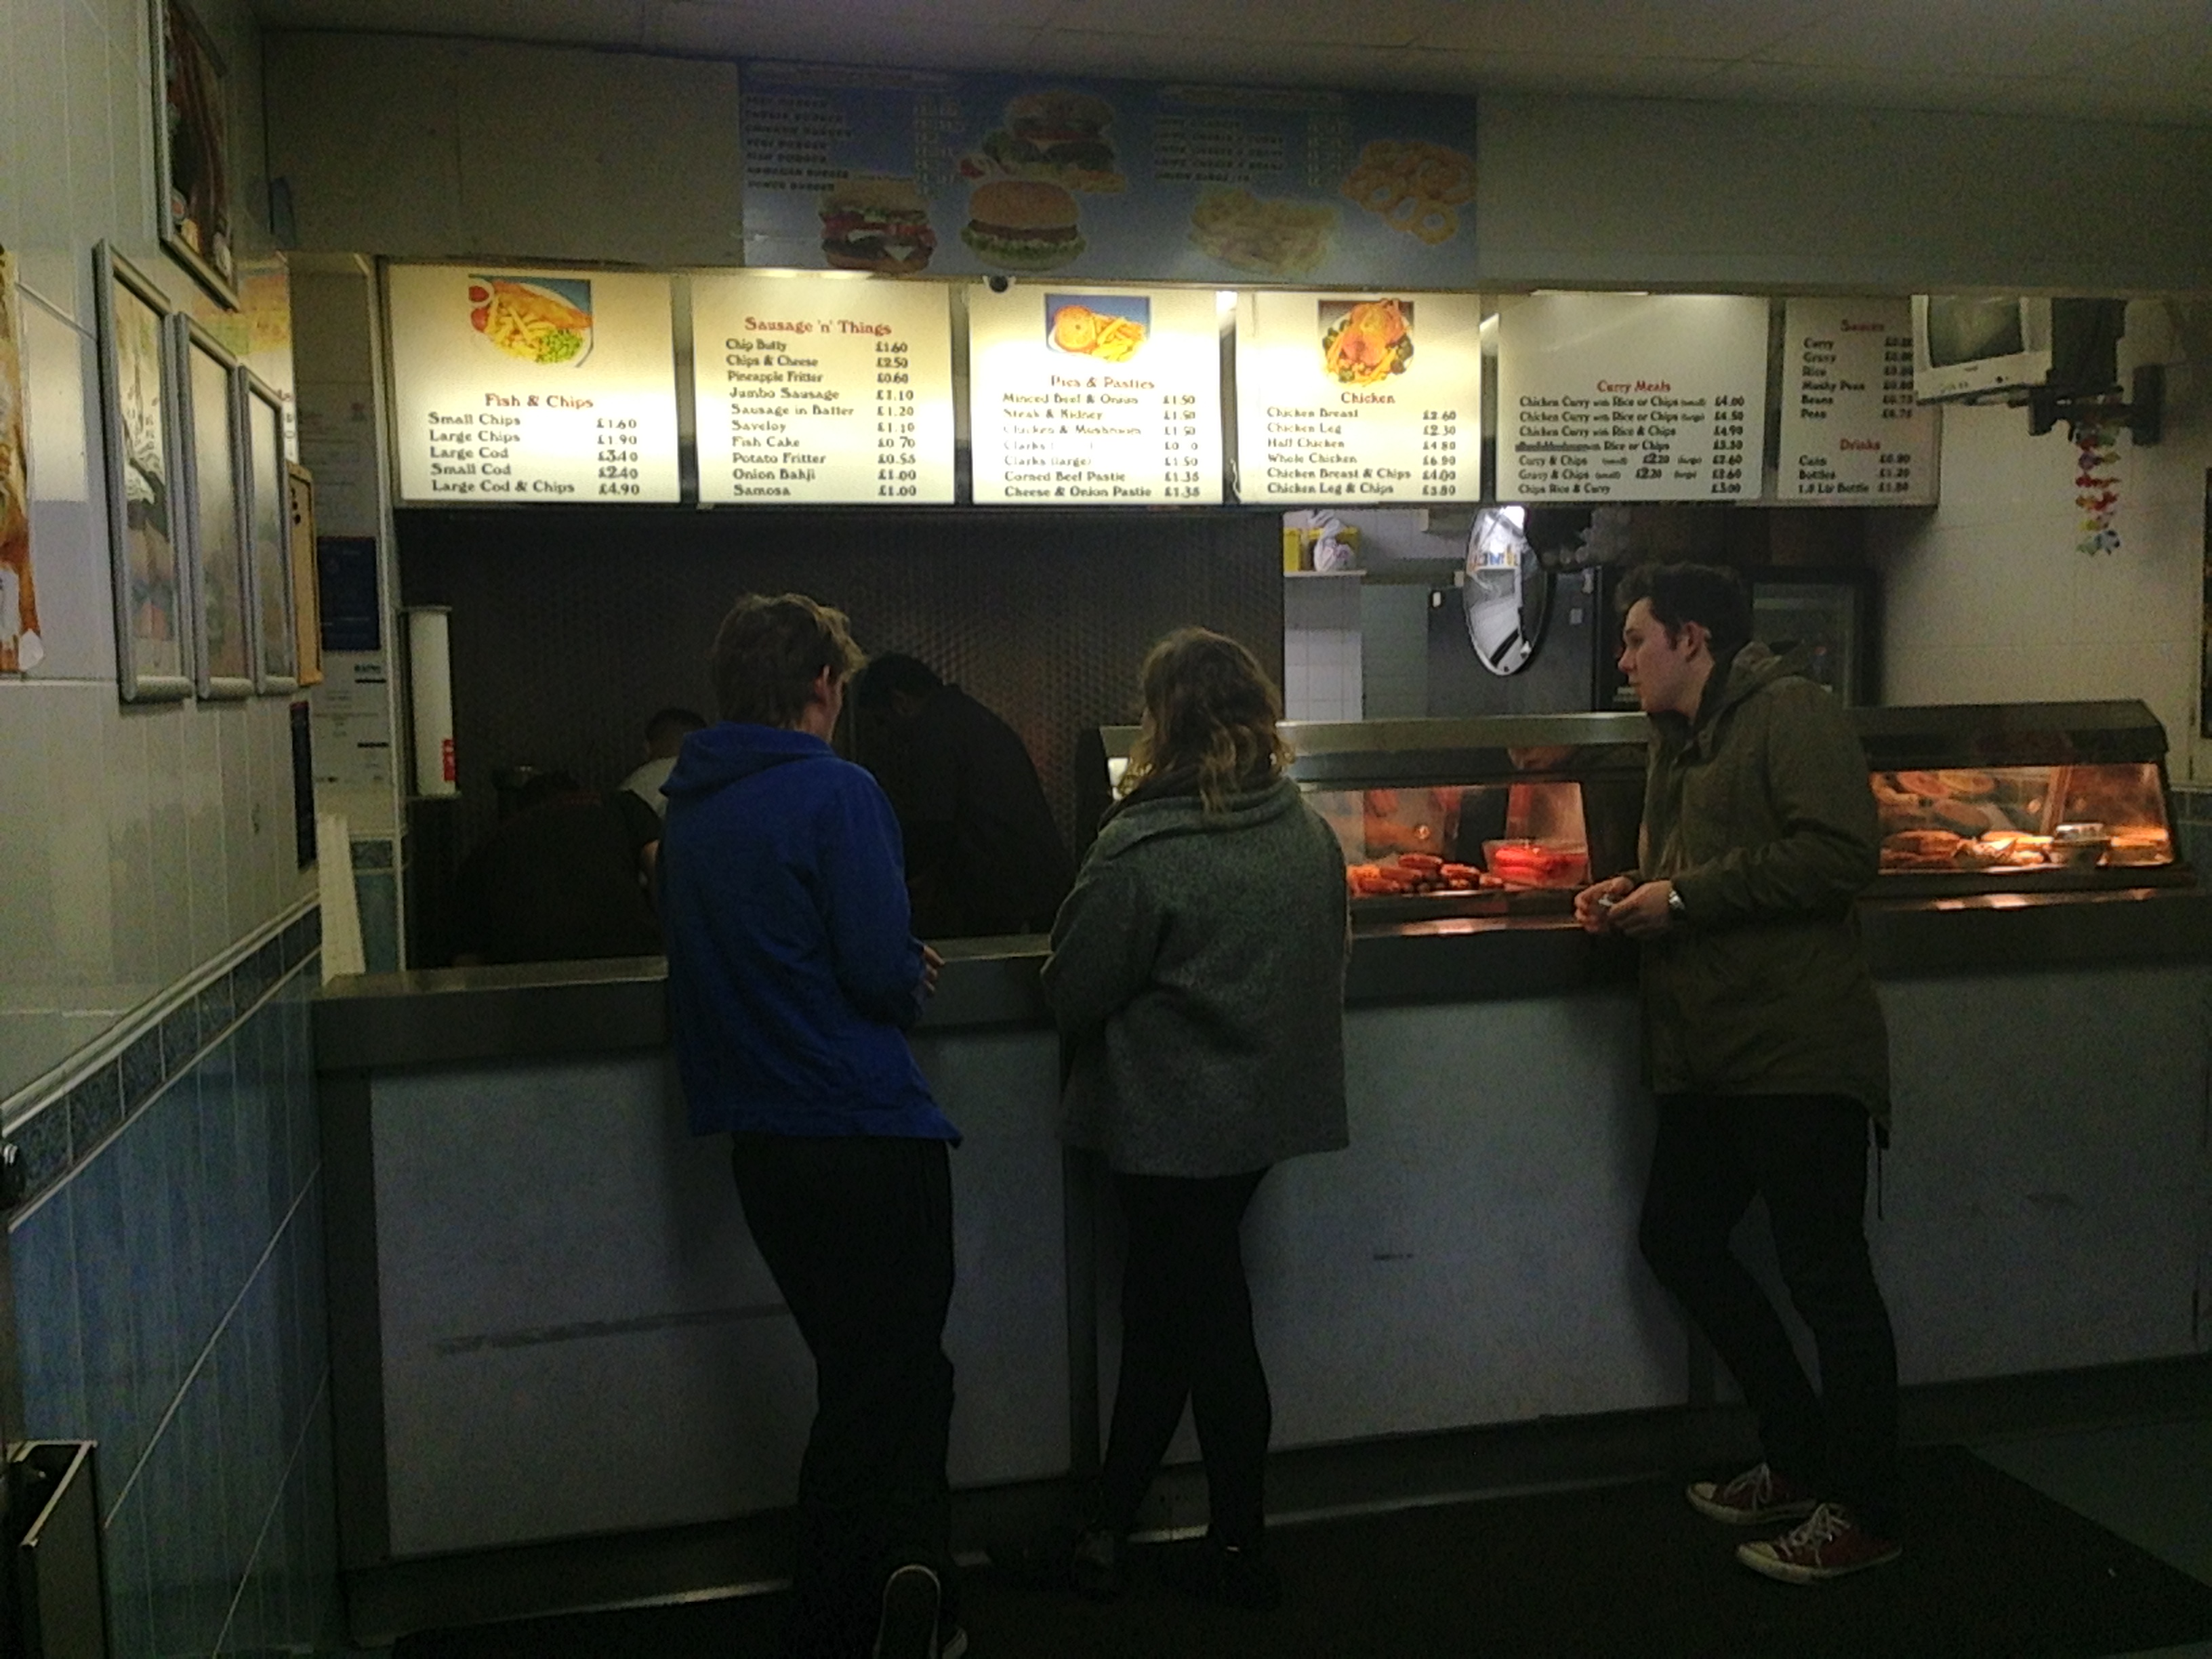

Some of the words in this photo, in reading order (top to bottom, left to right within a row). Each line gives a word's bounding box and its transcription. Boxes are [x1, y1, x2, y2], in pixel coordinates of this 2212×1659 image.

[745, 316, 813, 334] Sausage
[817, 320, 833, 333] 'n'
[838, 320, 892, 336] Things
[726, 338, 753, 352] Chip
[756, 339, 787, 352] Butty
[876, 342, 907, 352] £1.60
[1803, 337, 1834, 350] Curry
[726, 354, 760, 368] Chips
[764, 355, 773, 366] &
[777, 355, 818, 367] Cheese
[876, 358, 907, 368] £2.50
[1802, 366, 1826, 376] Rice
[728, 371, 783, 384] Pineapple
[787, 371, 823, 382] Fritter
[877, 373, 908, 384] £0.60
[1051, 375, 1080, 387] Pies
[1086, 377, 1097, 388] &
[1104, 377, 1155, 389] Pasties
[1597, 380, 1631, 393] Curry
[1635, 380, 1671, 392] Meals
[1840, 380, 1865, 390] Peas
[729, 387, 775, 398] Jumbo
[781, 387, 840, 401] Sausage
[876, 390, 914, 401] £1.10
[1002, 393, 1048, 403] Minced
[1054, 393, 1080, 403] Beef
[1086, 394, 1094, 403] &
[1341, 392, 1395, 404] Chicken
[485, 393, 520, 407] Fish
[527, 395, 539, 407] &
[546, 395, 593, 409] Chips
[1520, 396, 1559, 407] Chicken
[1562, 395, 1590, 409] Curry
[1612, 396, 1634, 406] Rice
[1651, 396, 1678, 407] Chips
[731, 404, 790, 416] Sausage
[795, 405, 807, 415] in
[813, 405, 854, 415] Batter
[877, 407, 914, 416] £1.20
[1046, 409, 1054, 418] &
[1061, 409, 1103, 420] Kidney
[1267, 407, 1315, 417] Chicken
[1320, 408, 1358, 417] Breast
[1801, 409, 1826, 418] Peas
[428, 412, 473, 425] Small
[479, 413, 520, 426] Chips
[596, 419, 637, 429] £1.60
[1519, 411, 1559, 422] Chicken
[1561, 411, 1590, 424] Curry
[1612, 411, 1634, 421] Rice
[1651, 411, 1678, 423] Chips
[731, 420, 786, 432] Saveloy
[878, 423, 914, 432] £1.10
[1059, 426, 1067, 434] &
[1267, 422, 1315, 432] Chicken
[1320, 423, 1341, 434] Leg
[1519, 426, 1559, 436] Chicken
[1561, 426, 1589, 439] Curry
[1612, 426, 1634, 436] Rice
[1637, 426, 1645, 436] &
[1648, 425, 1676, 438] Chips
[429, 430, 472, 443] Large
[478, 431, 520, 443] Chips
[732, 436, 761, 447] Fish
[766, 436, 800, 447] Cake
[1268, 438, 1292, 447] Half
[1298, 438, 1345, 447] Chicken
[1604, 441, 1624, 450] Rice
[1642, 441, 1670, 452] Chips
[1840, 439, 1881, 451] Drinks
[430, 446, 474, 459] Large
[479, 447, 508, 458] Cod
[598, 449, 638, 462] £3.40
[733, 452, 778, 464] Potato
[783, 453, 826, 464] Fritter
[1269, 453, 1303, 463] Whole
[1309, 453, 1357, 464] Chicken
[1004, 455, 1046, 466] Clarks
[1519, 455, 1545, 466] Curry
[1549, 456, 1557, 465] &
[1561, 455, 1587, 466] Chips
[431, 463, 475, 476] Small
[482, 463, 511, 475] Cod
[598, 466, 638, 479] £2.40
[733, 468, 775, 480] Onion
[780, 468, 815, 481] Bahji
[878, 470, 916, 481] £1.00
[1005, 472, 1050, 481] Corned
[1056, 472, 1082, 481] Beef
[1087, 472, 1125, 481] Pastie
[1267, 467, 1315, 478] Chicken
[1320, 468, 1359, 478] Breast
[1363, 468, 1372, 478] &
[1377, 468, 1411, 480] Chips
[1519, 469, 1547, 481] Gravy
[1551, 469, 1558, 479] &
[1563, 468, 1589, 480] Chips
[432, 479, 474, 494] Large
[480, 479, 510, 492] Cod
[515, 480, 527, 492] &
[533, 480, 575, 494] Chips
[598, 483, 640, 495] £4.90
[733, 485, 791, 496] Samosa
[878, 486, 916, 496] £1.00
[1005, 486, 1050, 497] Cheese
[1054, 487, 1065, 497] &
[1070, 487, 1108, 497] Onion
[1113, 487, 1151, 497] Pastie
[1267, 482, 1315, 493] Chicken
[1320, 482, 1341, 495] Leg
[1345, 483, 1355, 493] &
[1359, 483, 1393, 495] Chips
[1519, 484, 1545, 495] Chips
[1549, 484, 1569, 493] Rice
[1573, 484, 1580, 493] &
[1584, 483, 1610, 495] Curry
